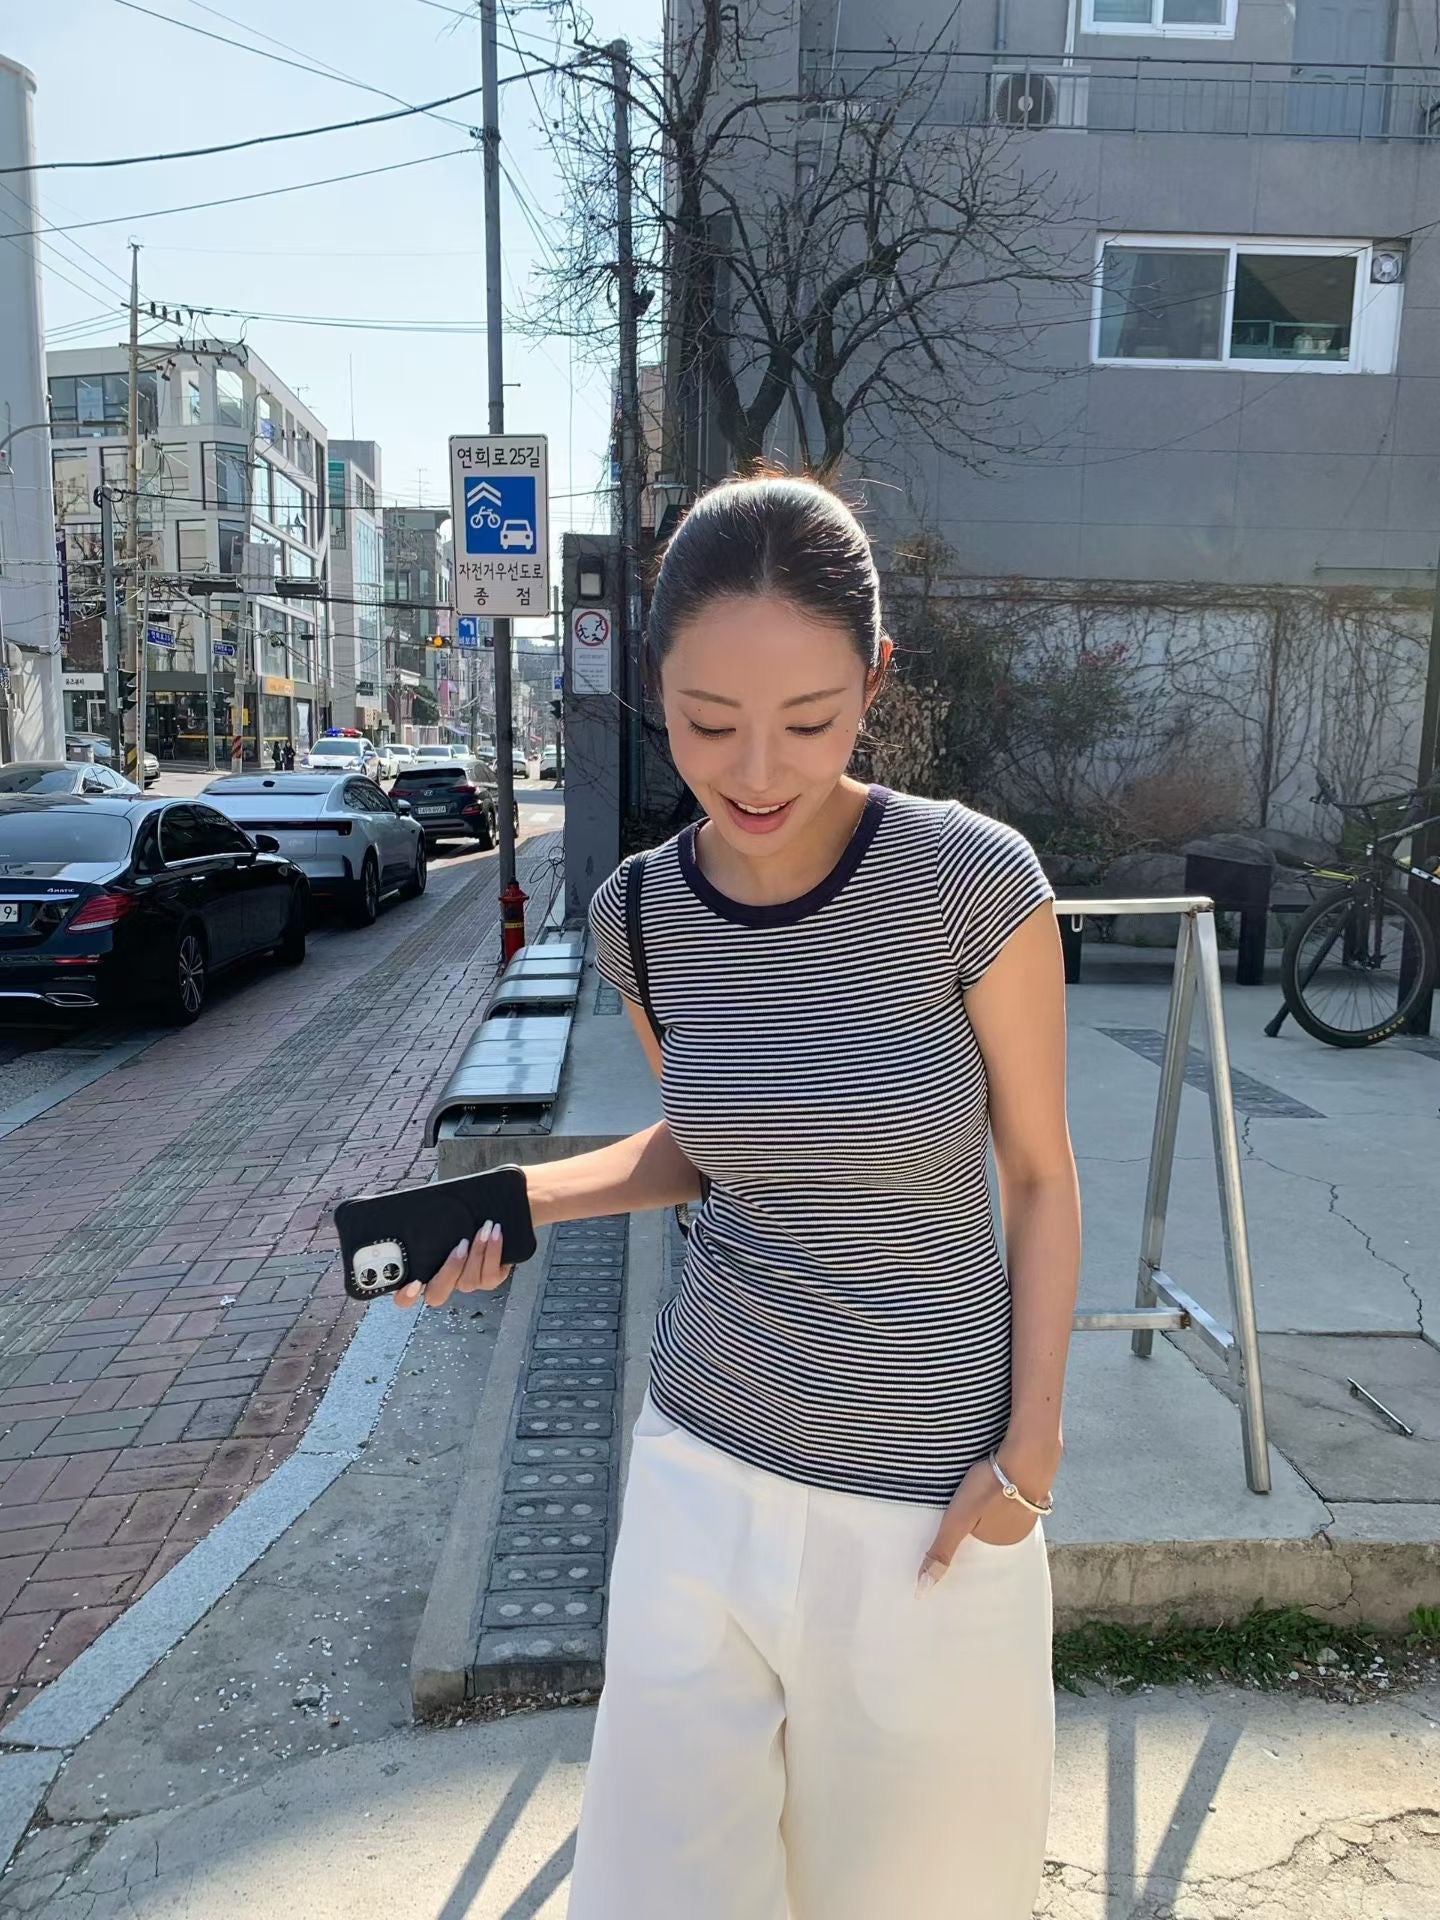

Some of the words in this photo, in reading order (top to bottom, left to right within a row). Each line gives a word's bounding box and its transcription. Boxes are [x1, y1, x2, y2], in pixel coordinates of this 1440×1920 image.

[457, 446, 540, 468] 연희로25길
[459, 562, 544, 581] 자전거우선도로
[473, 587, 489, 606] 종
[516, 587, 530, 606] 점
